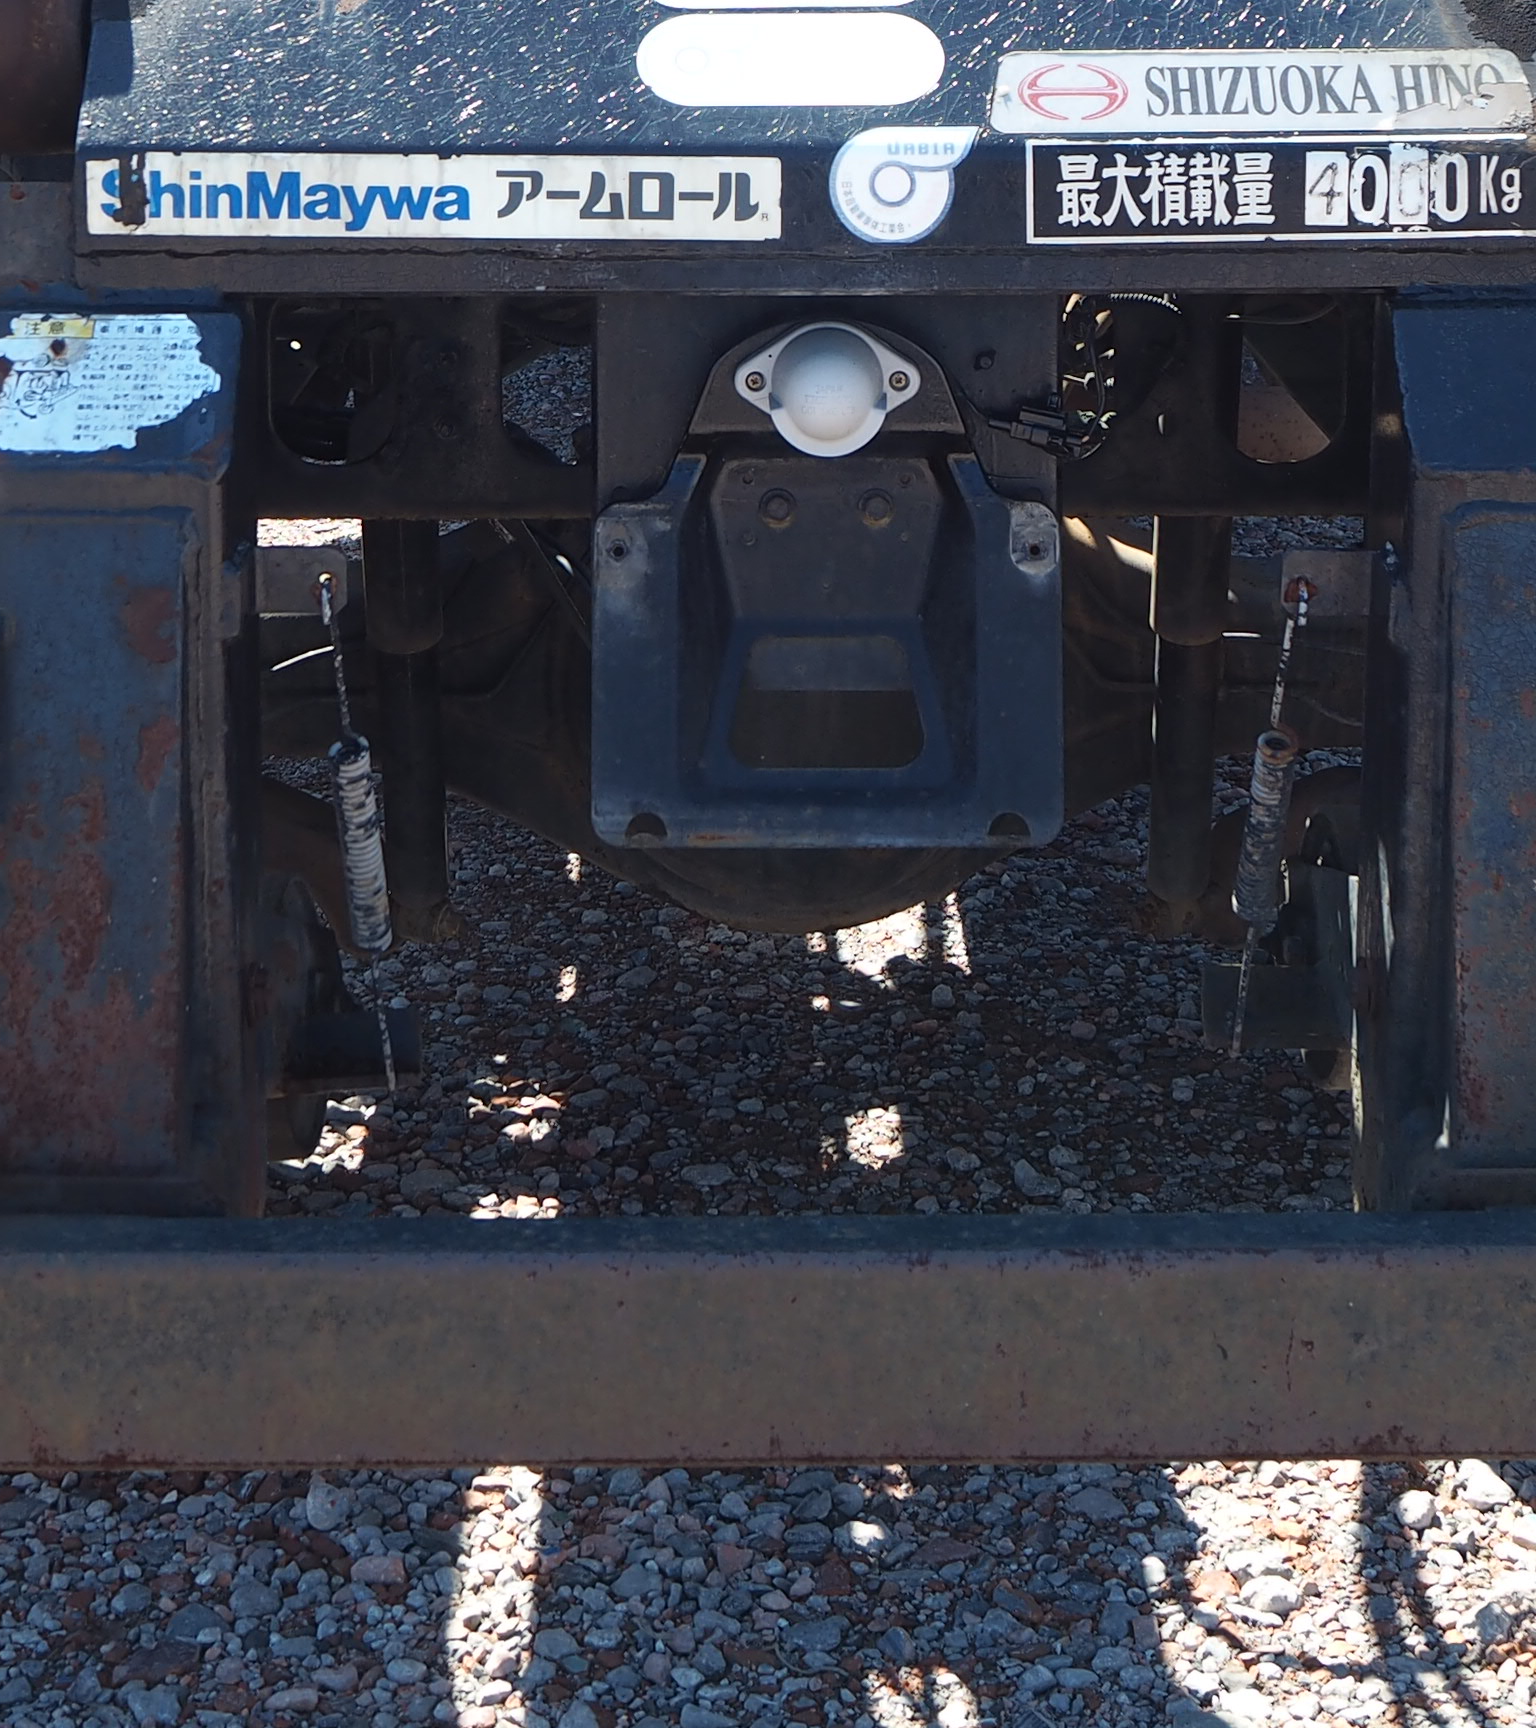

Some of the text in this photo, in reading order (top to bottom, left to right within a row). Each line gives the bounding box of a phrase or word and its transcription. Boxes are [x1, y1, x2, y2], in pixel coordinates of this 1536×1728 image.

[1146, 64, 1383, 117] SHIZUOKA
[496, 169, 760, 222] アームロール
[1056, 152, 1274, 227] 最大積載量
[24, 321, 65, 336] 注意
